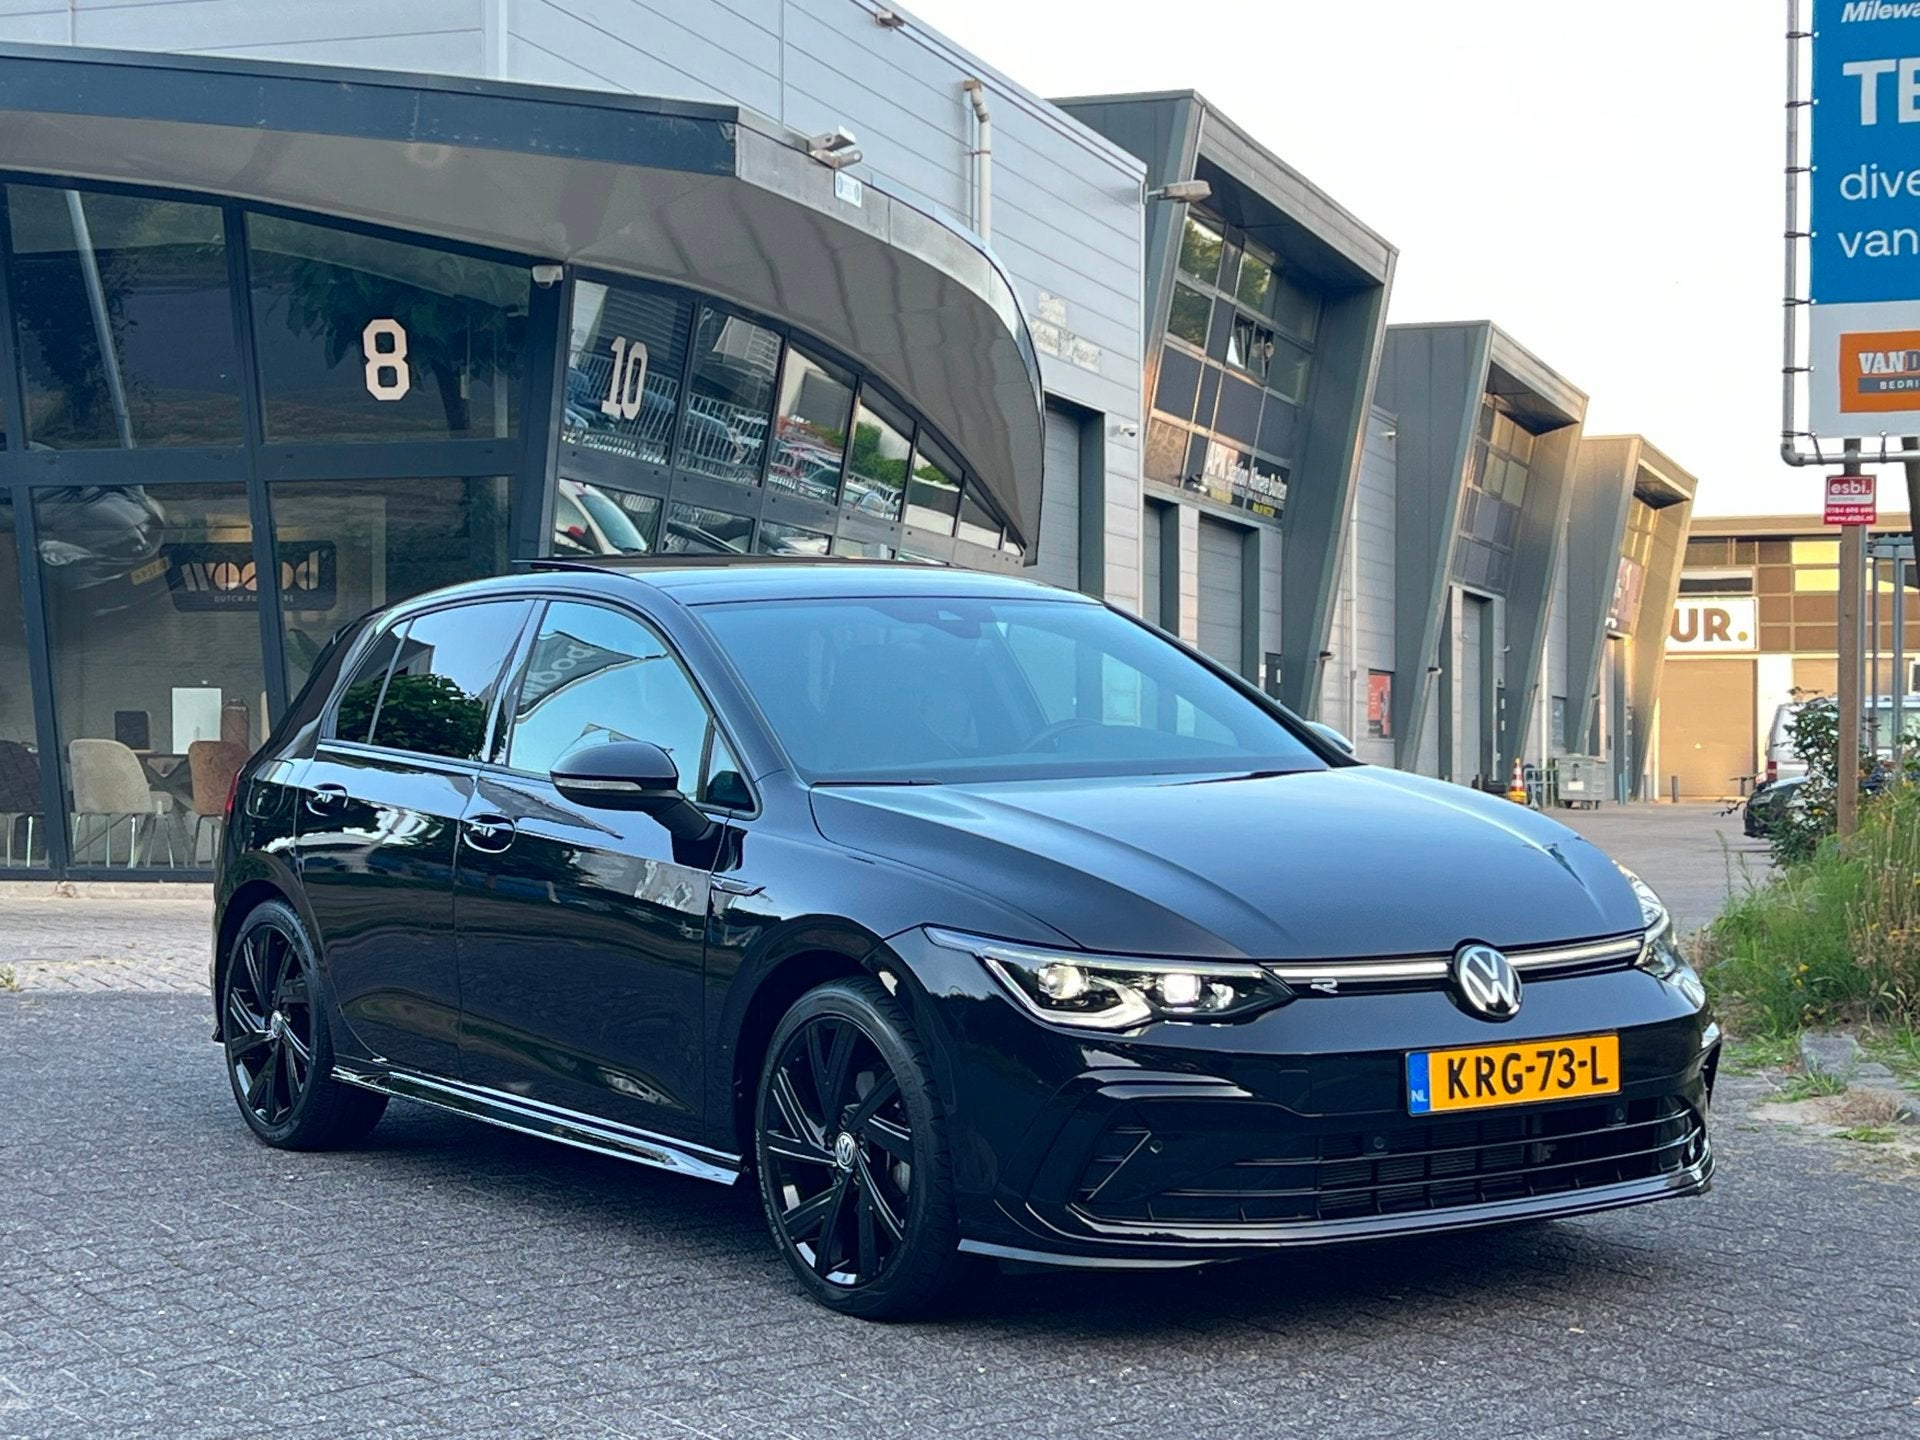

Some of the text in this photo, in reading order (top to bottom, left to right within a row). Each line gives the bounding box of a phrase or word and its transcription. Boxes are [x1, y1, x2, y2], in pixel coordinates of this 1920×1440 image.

[1837, 228, 1919, 258] van
[362, 318, 411, 401] 8
[601, 335, 649, 421] 10
[1410, 1088, 1429, 1103] NL
[1447, 1045, 1609, 1099] KRG-73-L
